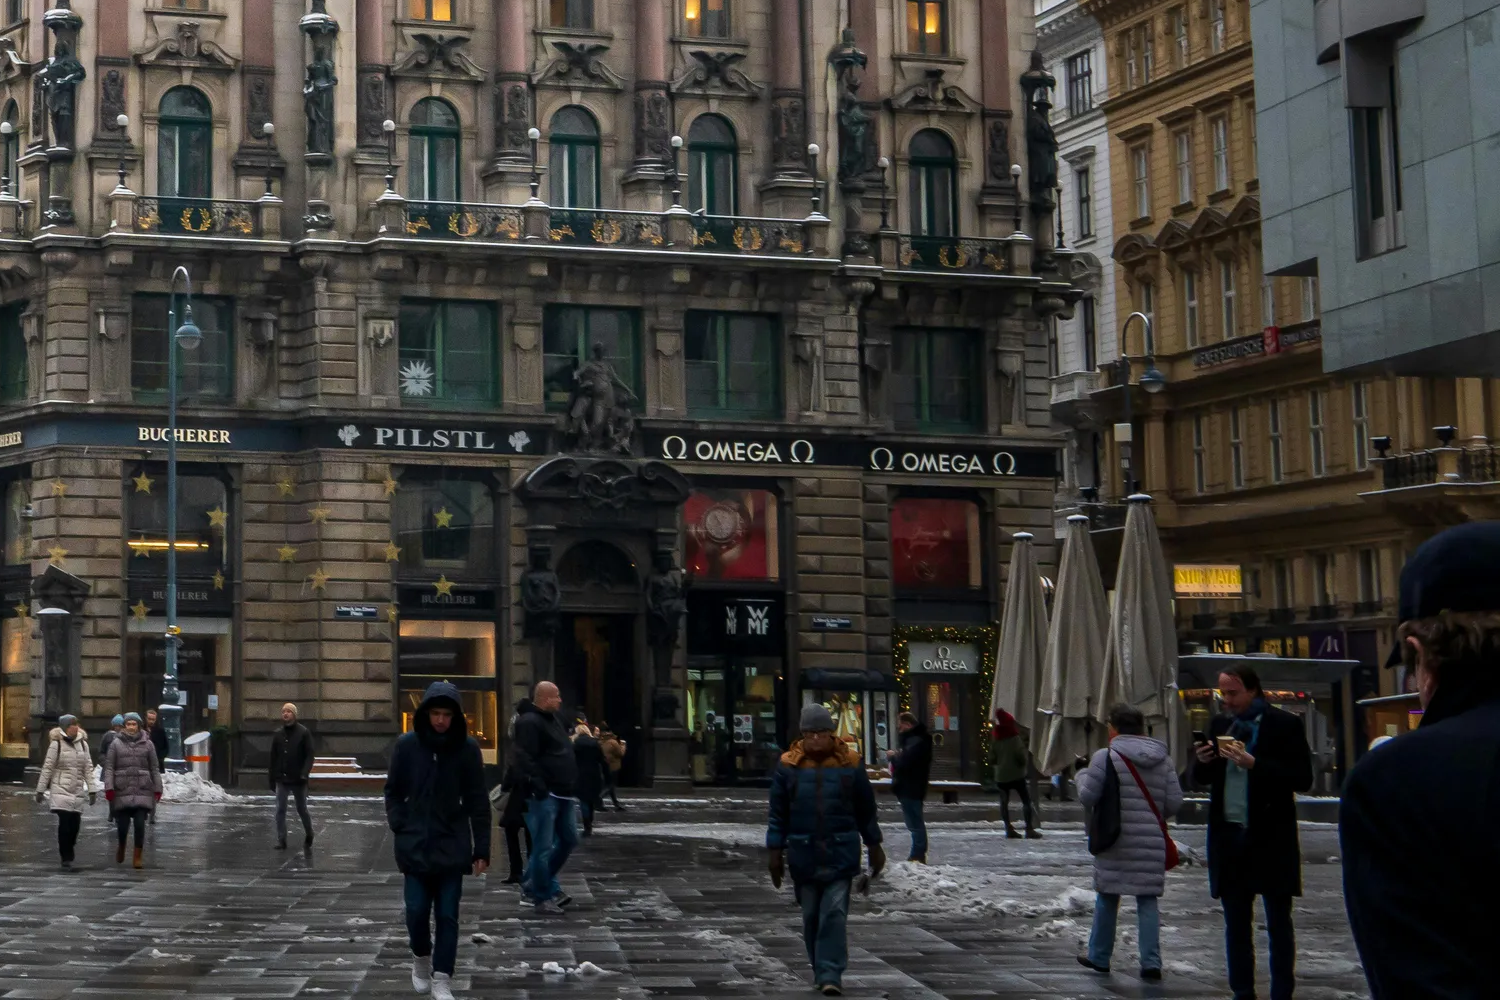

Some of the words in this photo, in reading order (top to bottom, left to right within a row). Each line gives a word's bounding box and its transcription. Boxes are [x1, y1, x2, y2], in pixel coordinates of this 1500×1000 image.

[374, 427, 496, 450] PILSTL
[694, 440, 782, 463] OMEGA
[901, 452, 985, 474] OMEGA
[922, 659, 968, 671] OMEGA
